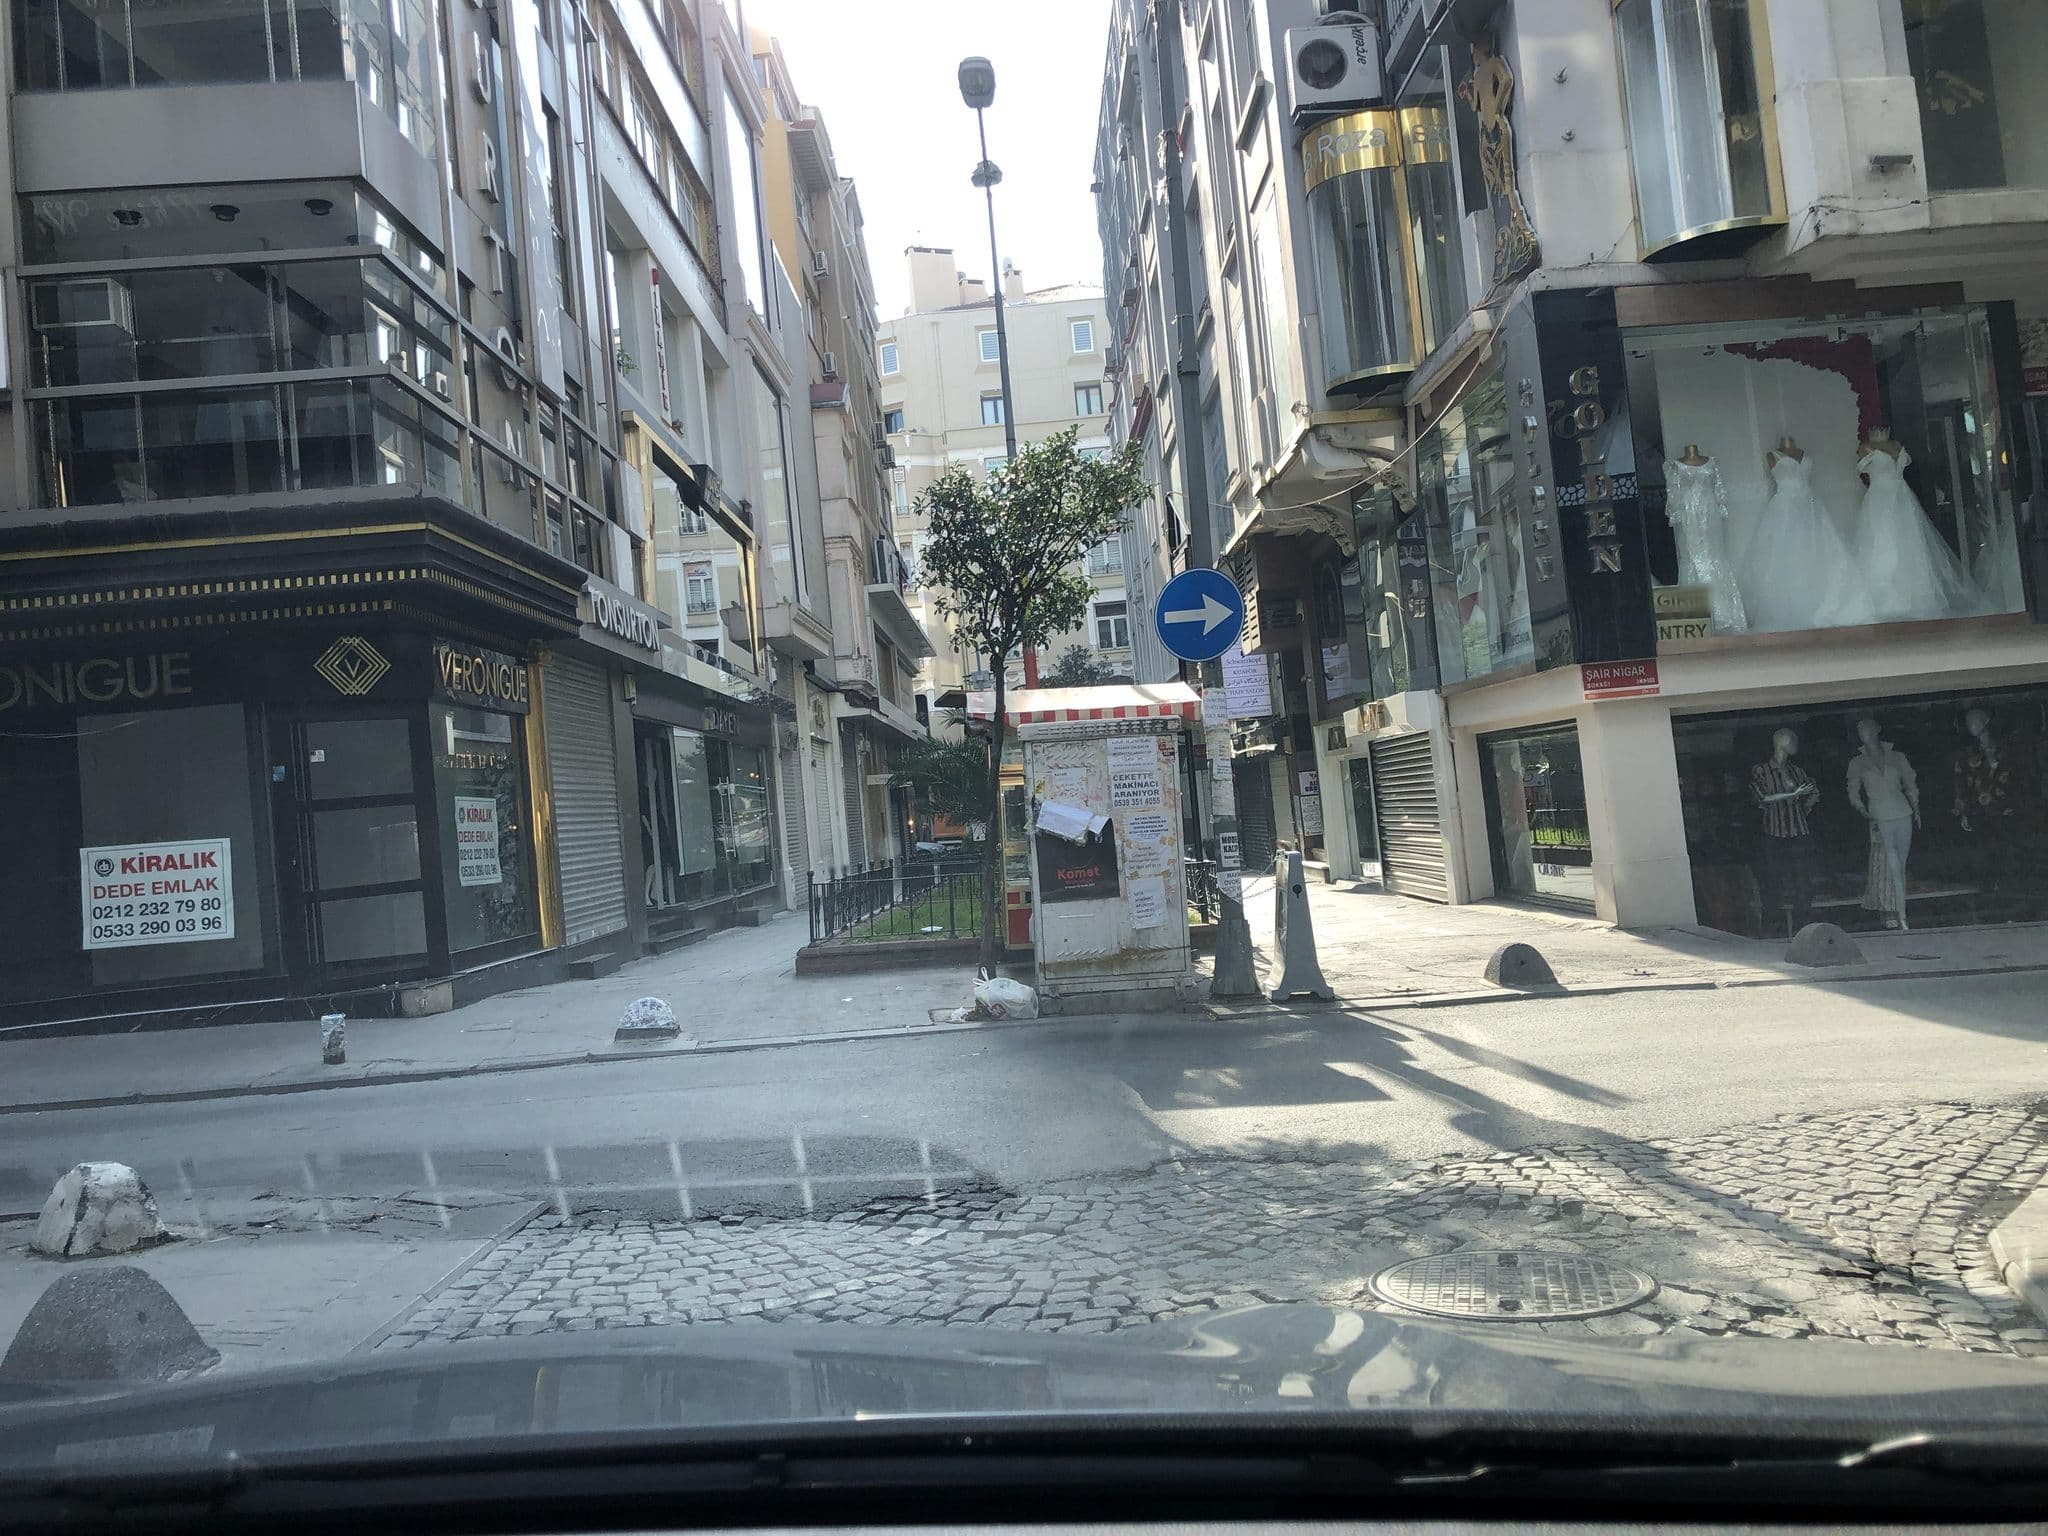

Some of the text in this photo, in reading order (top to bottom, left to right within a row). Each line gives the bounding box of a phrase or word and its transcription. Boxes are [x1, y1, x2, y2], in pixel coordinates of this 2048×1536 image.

[1352, 26, 1367, 65] arçelik
[1317, 128, 1387, 162] Roza
[1569, 365, 1624, 574] GOLDEN
[587, 584, 661, 651] TONSURTON
[440, 650, 528, 703] VERONIGUE
[1585, 665, 1646, 682] ŞAİR NİGAR
[1113, 789, 1160, 798] ARANIYOR
[1114, 781, 1159, 790] MAKİNACI
[120, 851, 218, 875] KİRALIK
[93, 877, 219, 900] DEDE EMLAK
[92, 897, 221, 920] 0212 232 79 80
[92, 916, 222, 939] 0533 290 03 96
